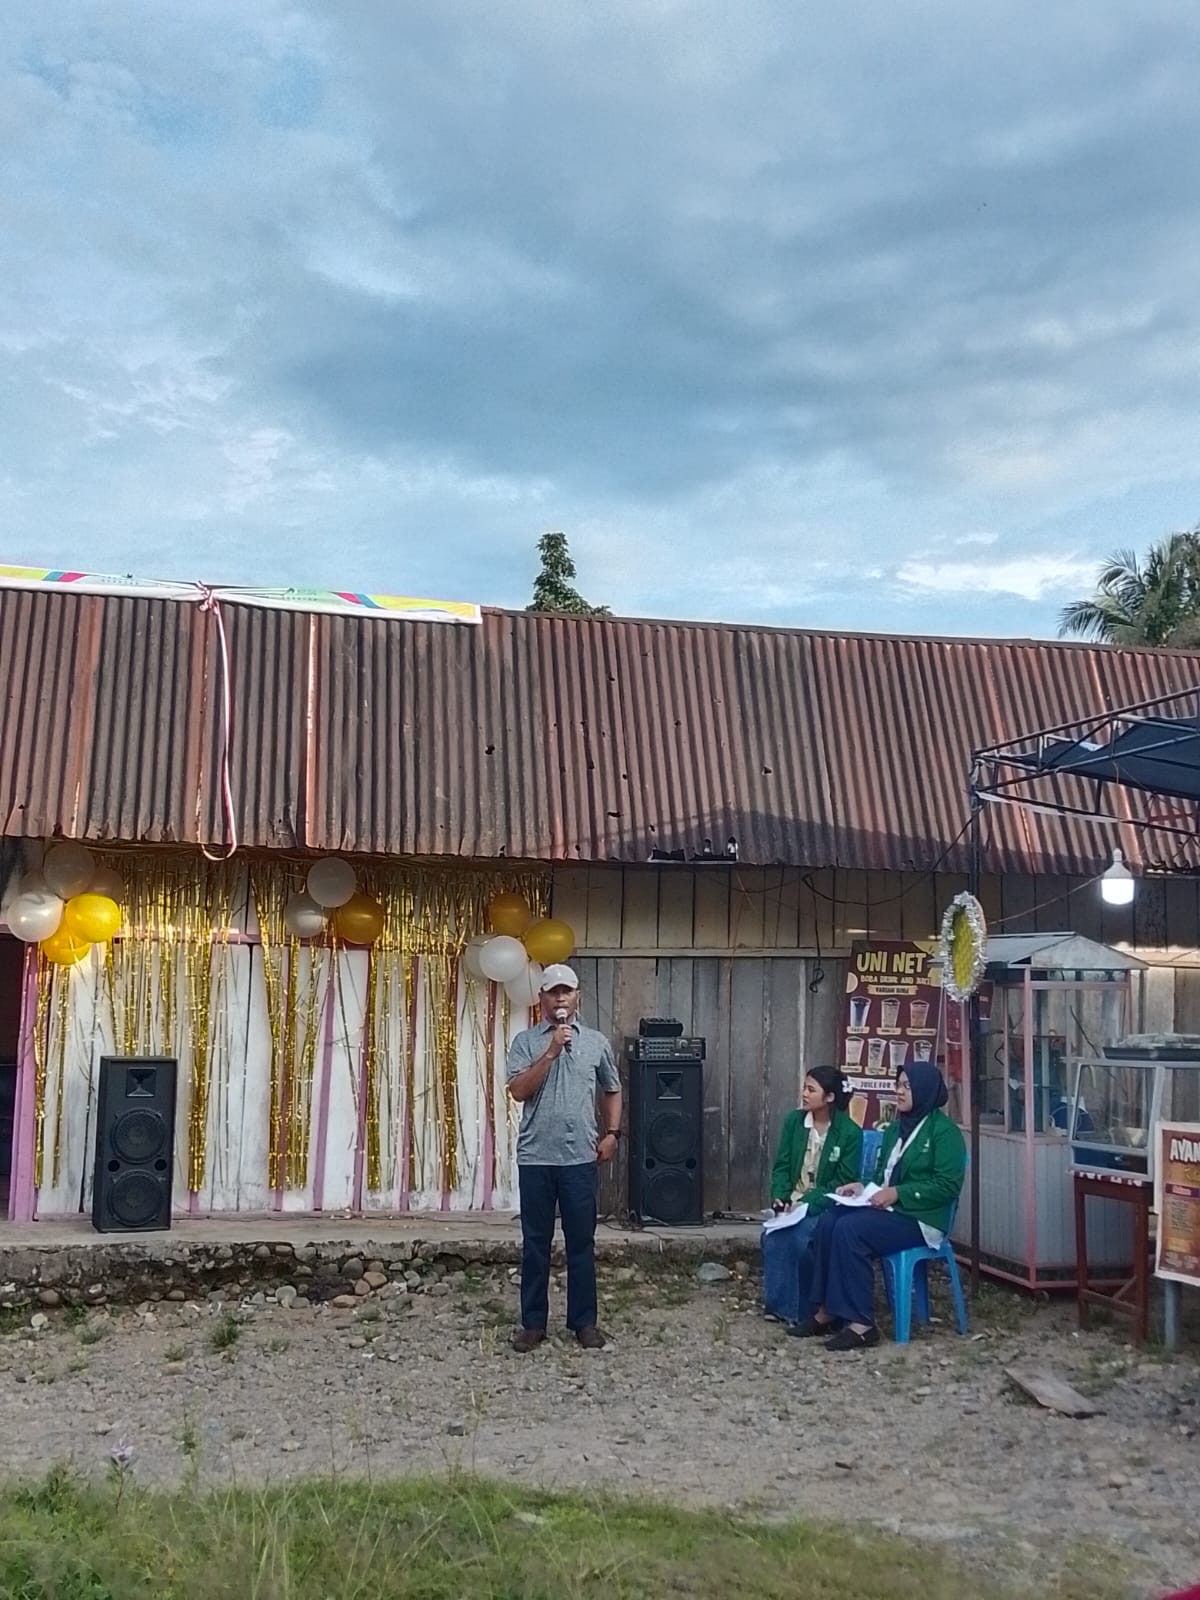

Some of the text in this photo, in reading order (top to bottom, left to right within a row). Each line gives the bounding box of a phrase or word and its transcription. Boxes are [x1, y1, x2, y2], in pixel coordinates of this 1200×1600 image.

[856, 951, 927, 974] UNI NET
[900, 976, 914, 985] AND
[879, 1081, 891, 1089] FOR
